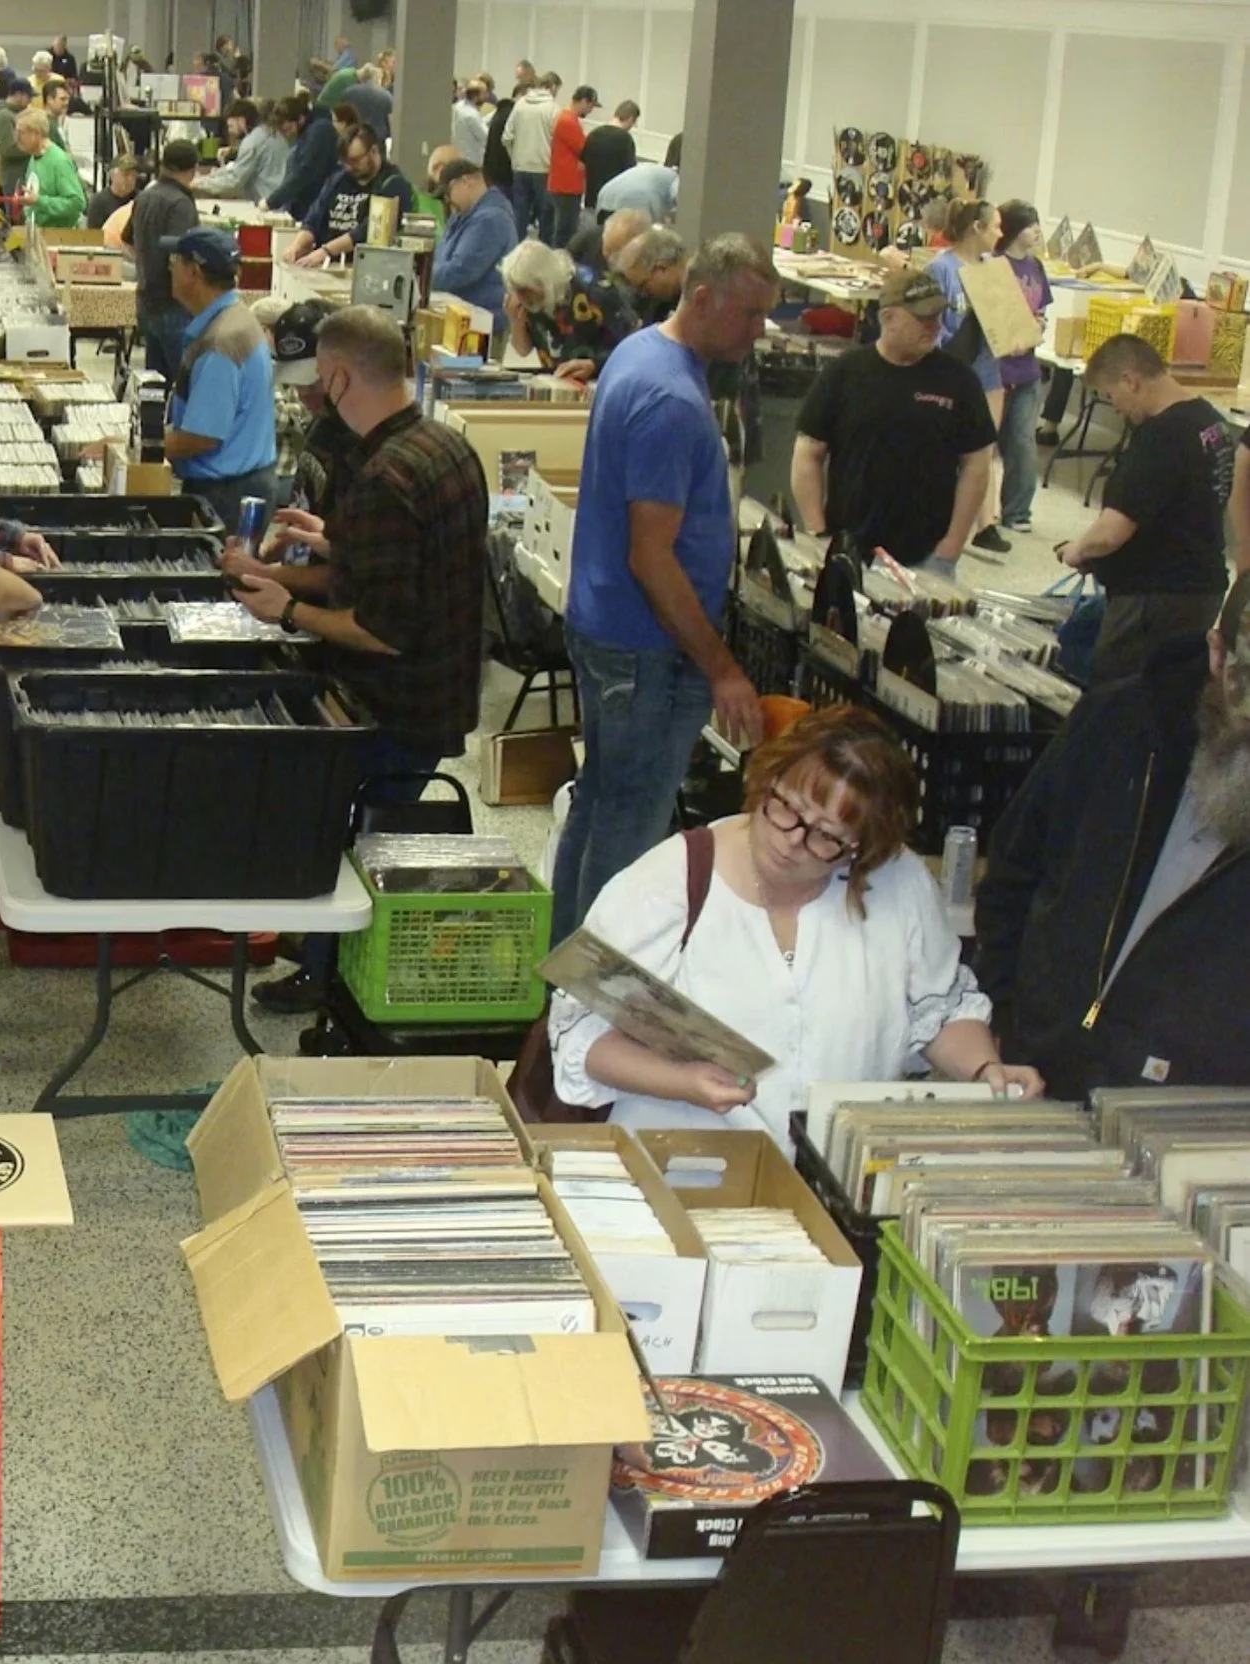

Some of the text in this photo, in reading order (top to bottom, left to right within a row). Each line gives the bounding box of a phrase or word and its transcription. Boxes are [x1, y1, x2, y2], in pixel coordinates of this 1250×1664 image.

[970, 1276, 1039, 1301] 1984
[734, 1377, 778, 1386] Clock
[379, 1468, 446, 1499] 100%
[472, 1470, 510, 1483] NEED
[471, 1484, 504, 1497] TAKE
[375, 1492, 454, 1519] BUY-BACK
[506, 1500, 533, 1512] Buy
[376, 1511, 457, 1534] GUARANTEE
[696, 1518, 736, 1532] Clock
[709, 1533, 735, 1548] ing
